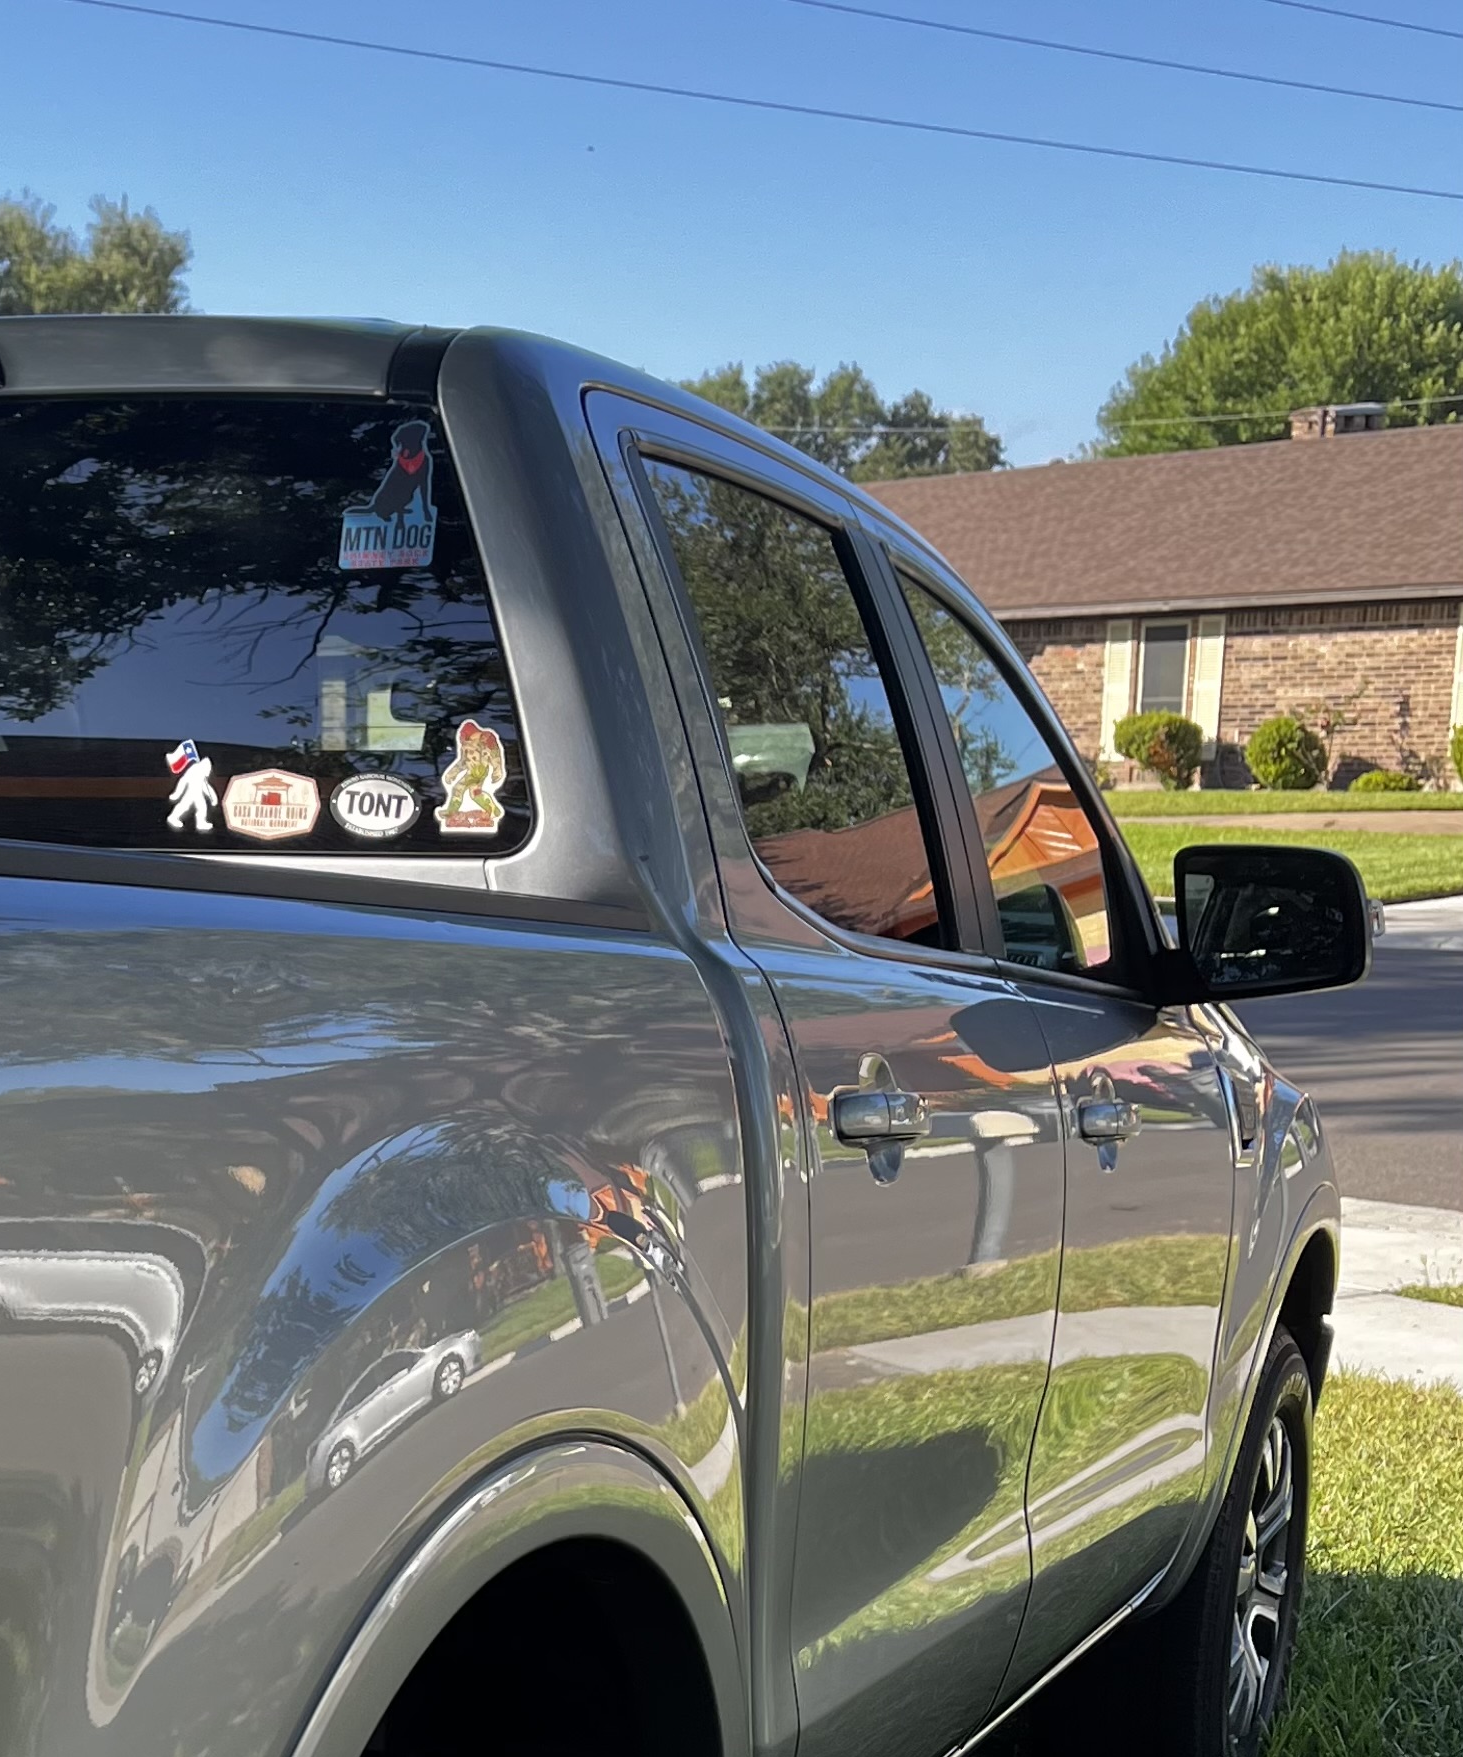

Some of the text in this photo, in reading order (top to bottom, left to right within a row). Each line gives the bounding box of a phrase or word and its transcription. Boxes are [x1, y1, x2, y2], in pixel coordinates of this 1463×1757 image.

[344, 523, 433, 552] MTN DOG
[345, 790, 409, 819] TONT
